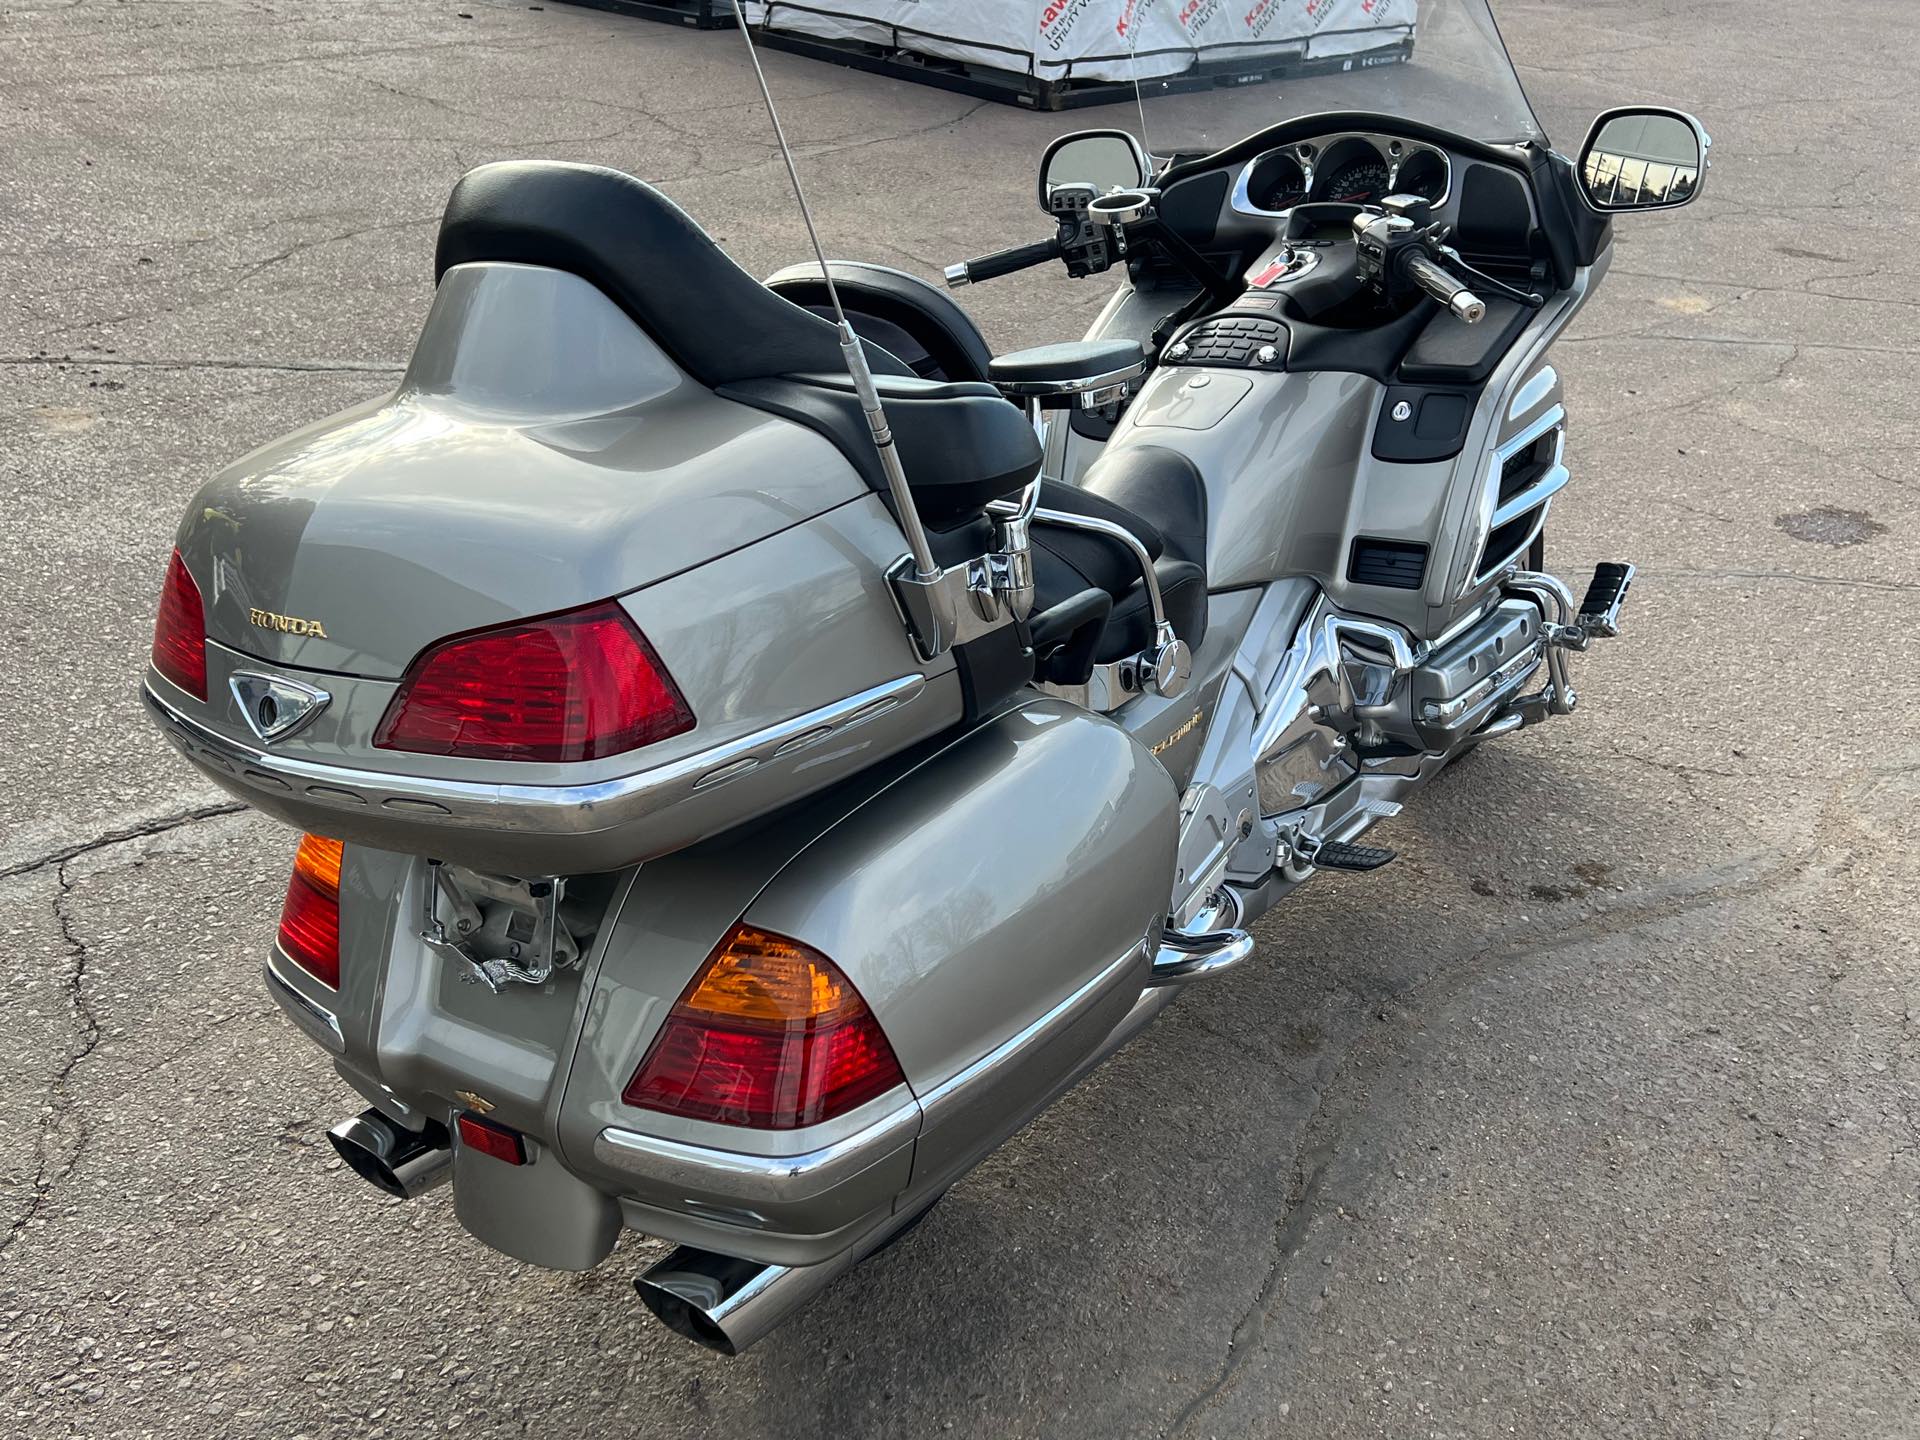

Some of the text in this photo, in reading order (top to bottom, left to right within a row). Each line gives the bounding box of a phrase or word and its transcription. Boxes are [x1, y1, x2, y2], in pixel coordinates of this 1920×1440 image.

[1049, 7, 1079, 51] UTILITY
[1190, 0, 1218, 39] UTILITY
[250, 607, 328, 639] HONDA
